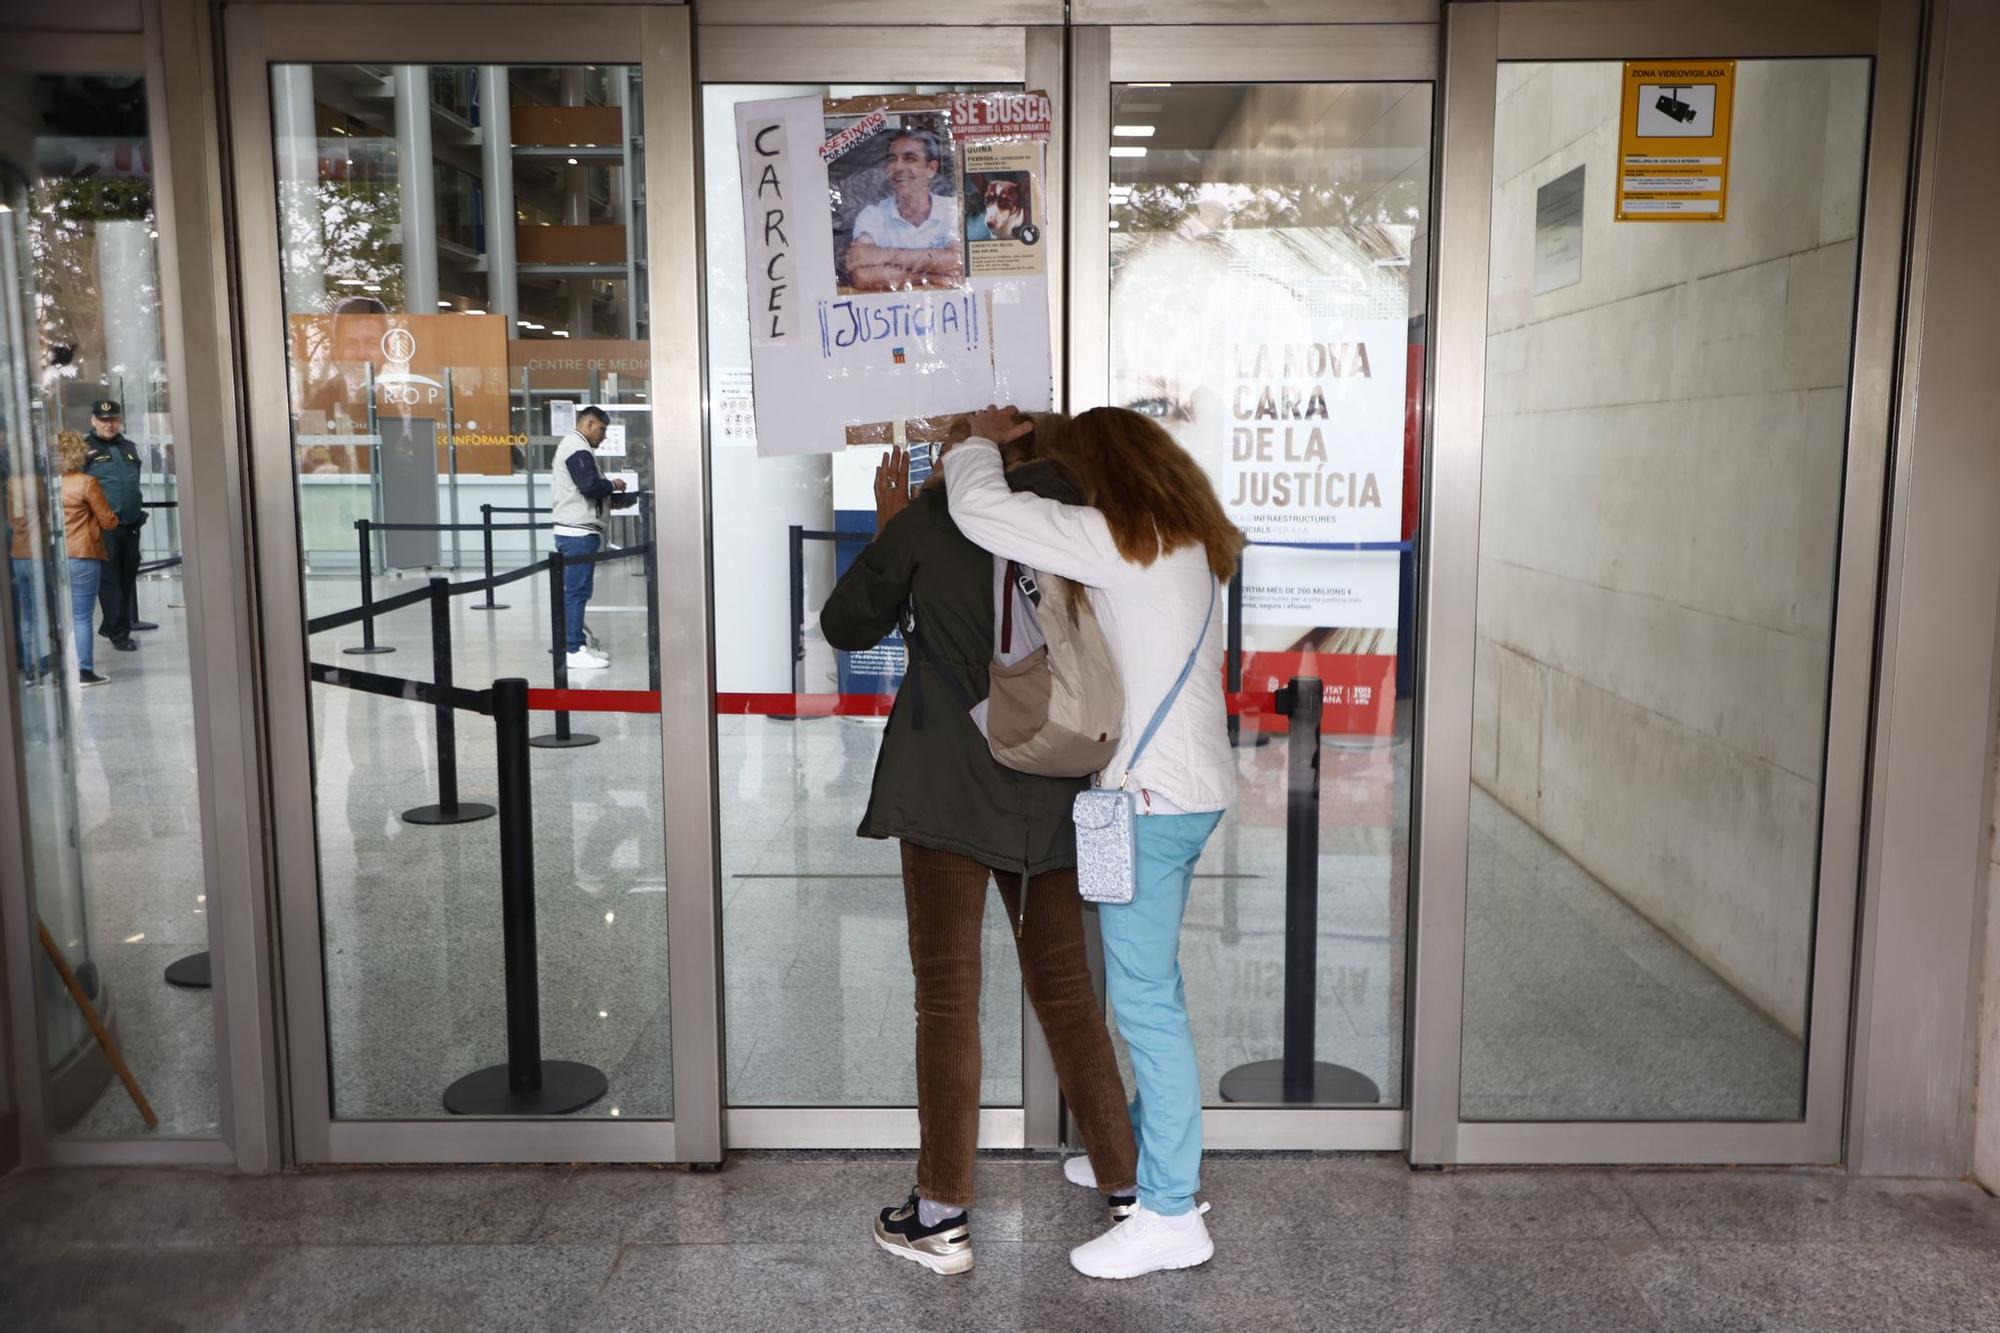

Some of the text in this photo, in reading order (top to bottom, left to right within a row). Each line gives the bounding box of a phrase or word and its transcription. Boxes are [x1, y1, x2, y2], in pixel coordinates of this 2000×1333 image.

[1631, 69, 1726, 78] ZONA VIDEOVIGILADA
[955, 95, 1051, 125] SE BUSCA
[818, 112, 882, 157] ASESINADO
[967, 146, 993, 154] QUINA
[754, 125, 789, 338] CARCEL
[528, 358, 584, 371] CENTRE
[587, 359, 606, 371] DE
[1234, 342, 1372, 378] LA NOVA
[384, 387, 438, 405] ROP
[1232, 384, 1329, 420] CARA
[452, 433, 528, 446] INFORMACIÓ
[1232, 427, 1329, 462] DE LA
[1230, 463, 1382, 508] JUSTÍCIA
[1239, 526, 1272, 534] DICIALS
[1297, 587, 1312, 595] 200
[1313, 588, 1346, 596] MILIONS
